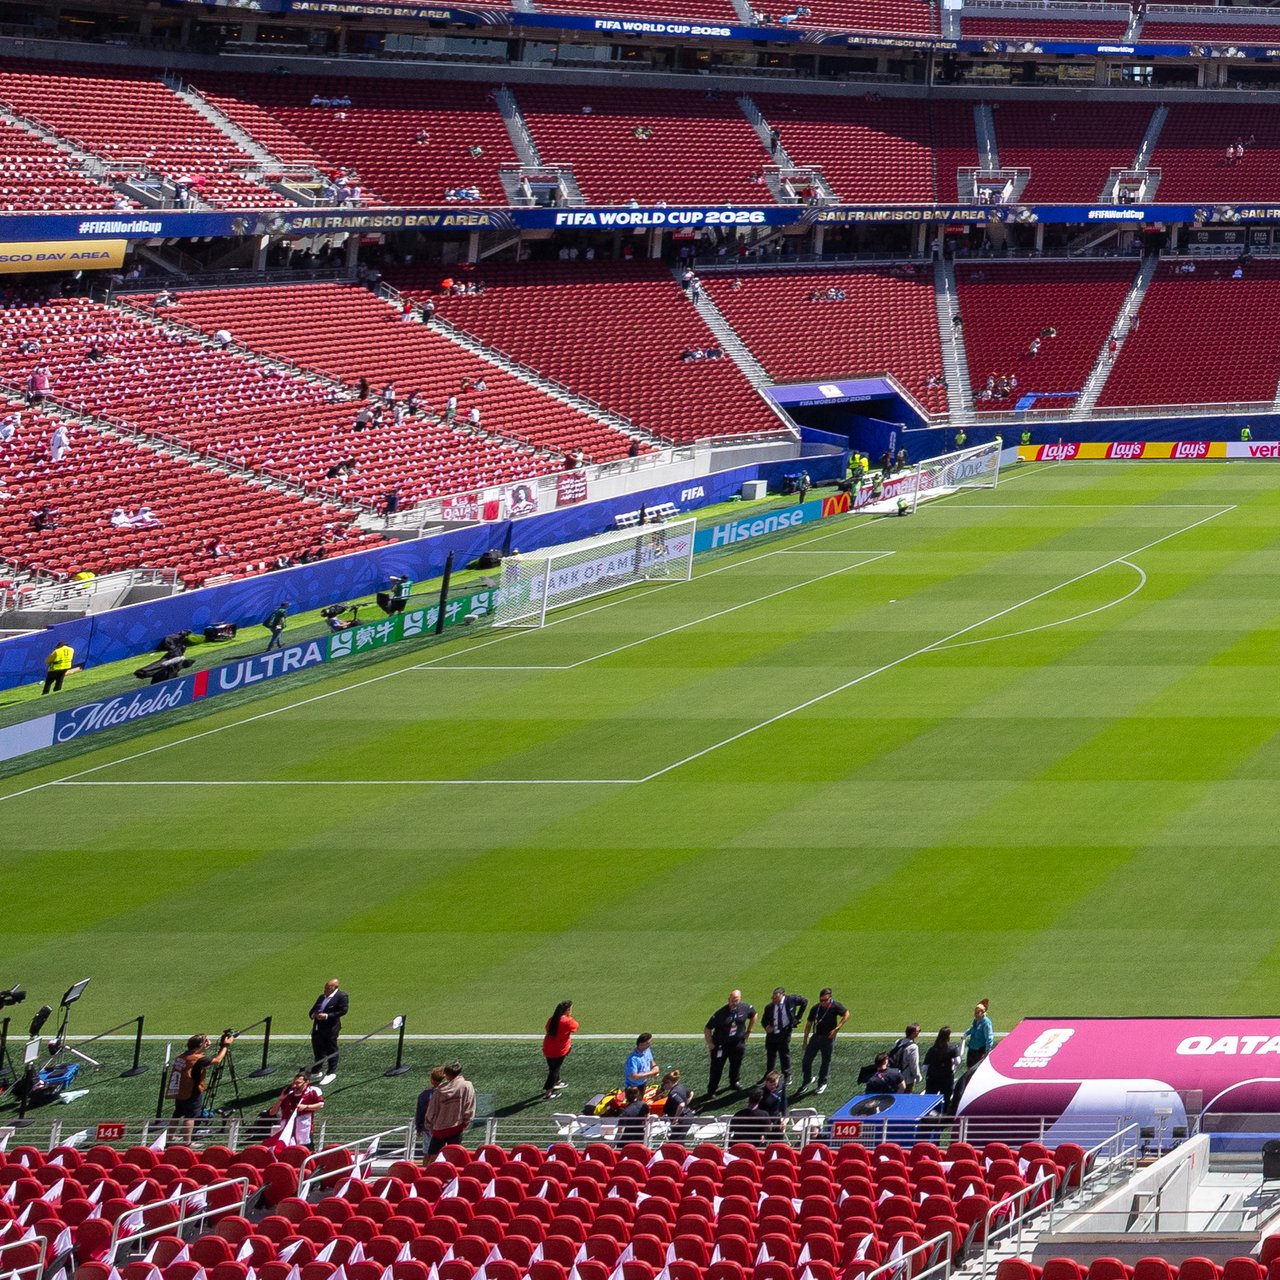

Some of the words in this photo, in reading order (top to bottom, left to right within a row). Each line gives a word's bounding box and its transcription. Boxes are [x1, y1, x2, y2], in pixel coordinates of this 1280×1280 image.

[595, 21, 621, 31] FIFA
[623, 22, 665, 33] WORLD
[667, 24, 690, 34] CUP
[691, 25, 730, 36] 2026
[556, 212, 596, 225] FIFA
[599, 212, 665, 224] WORLD
[668, 211, 703, 224] CUP
[705, 211, 765, 223] 2026
[818, 211, 846, 220] SAN
[848, 211, 921, 220] FRANCISCO
[923, 211, 950, 219] BAY
[952, 210, 986, 219] AREA
[1241, 209, 1264, 218] SAN
[79, 220, 162, 234] #FIFAWorldCup
[292, 216, 322, 228] SAN
[324, 216, 402, 228] FRANCISCO
[405, 215, 440, 226] BAY
[443, 214, 489, 226] AREA
[31, 253, 65, 261] BAY
[70, 251, 110, 261] AREA
[1042, 443, 1075, 460] Lay's
[1111, 443, 1141, 459] Lay's
[1176, 442, 1207, 457] Lay's
[681, 485, 704, 501] FIFA
[711, 507, 804, 547] Hisense
[355, 623, 394, 650] 蒙牛
[58, 681, 186, 743] Michelob
[220, 642, 322, 690] ULTRA
[98, 1128, 118, 1138] 141
[834, 1124, 857, 1136] 140
